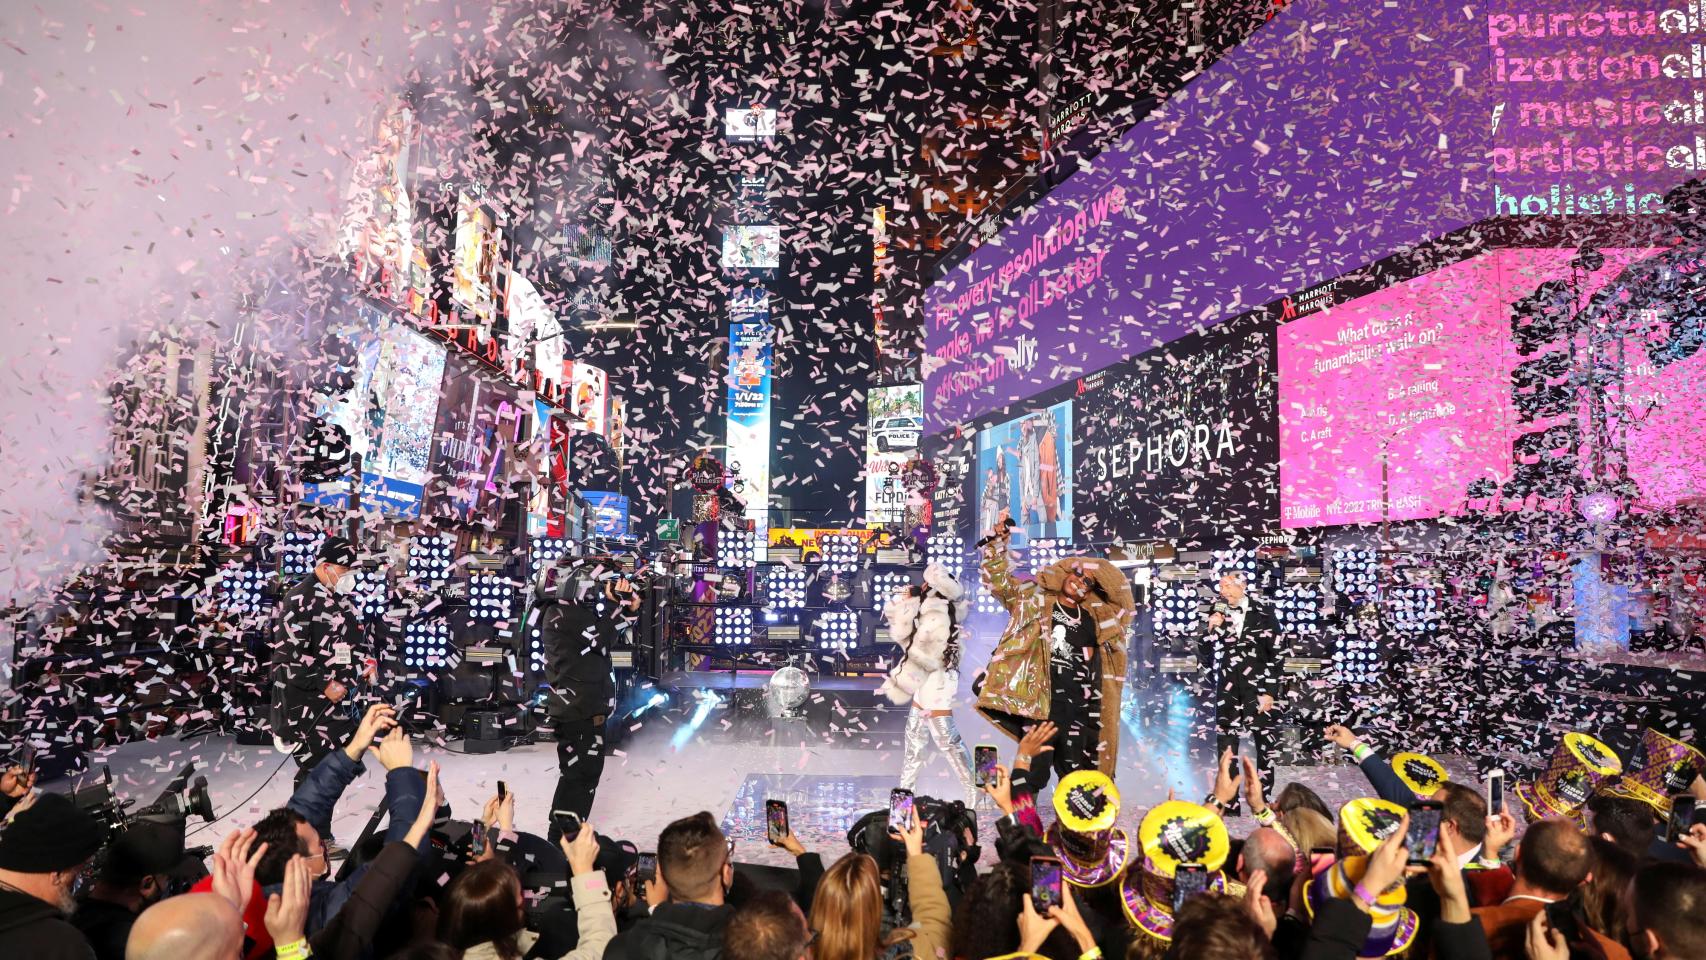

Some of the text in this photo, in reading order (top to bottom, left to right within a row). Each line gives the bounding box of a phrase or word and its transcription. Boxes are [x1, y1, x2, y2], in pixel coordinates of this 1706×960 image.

[957, 273, 996, 316] every
[999, 211, 1087, 288] resolution
[1092, 186, 1126, 227] we
[1018, 279, 1039, 321] all
[1299, 282, 1338, 302] MARRIOTT
[1299, 295, 1333, 313] MARQUIS
[1337, 323, 1369, 346] What
[1085, 370, 1107, 383] MARRIOTT
[1311, 429, 1316, 441] A
[1097, 418, 1235, 482] SEPHORA
[1558, 778, 1585, 796] planet
[1070, 789, 1095, 812] planet
[1167, 821, 1193, 853] planet
